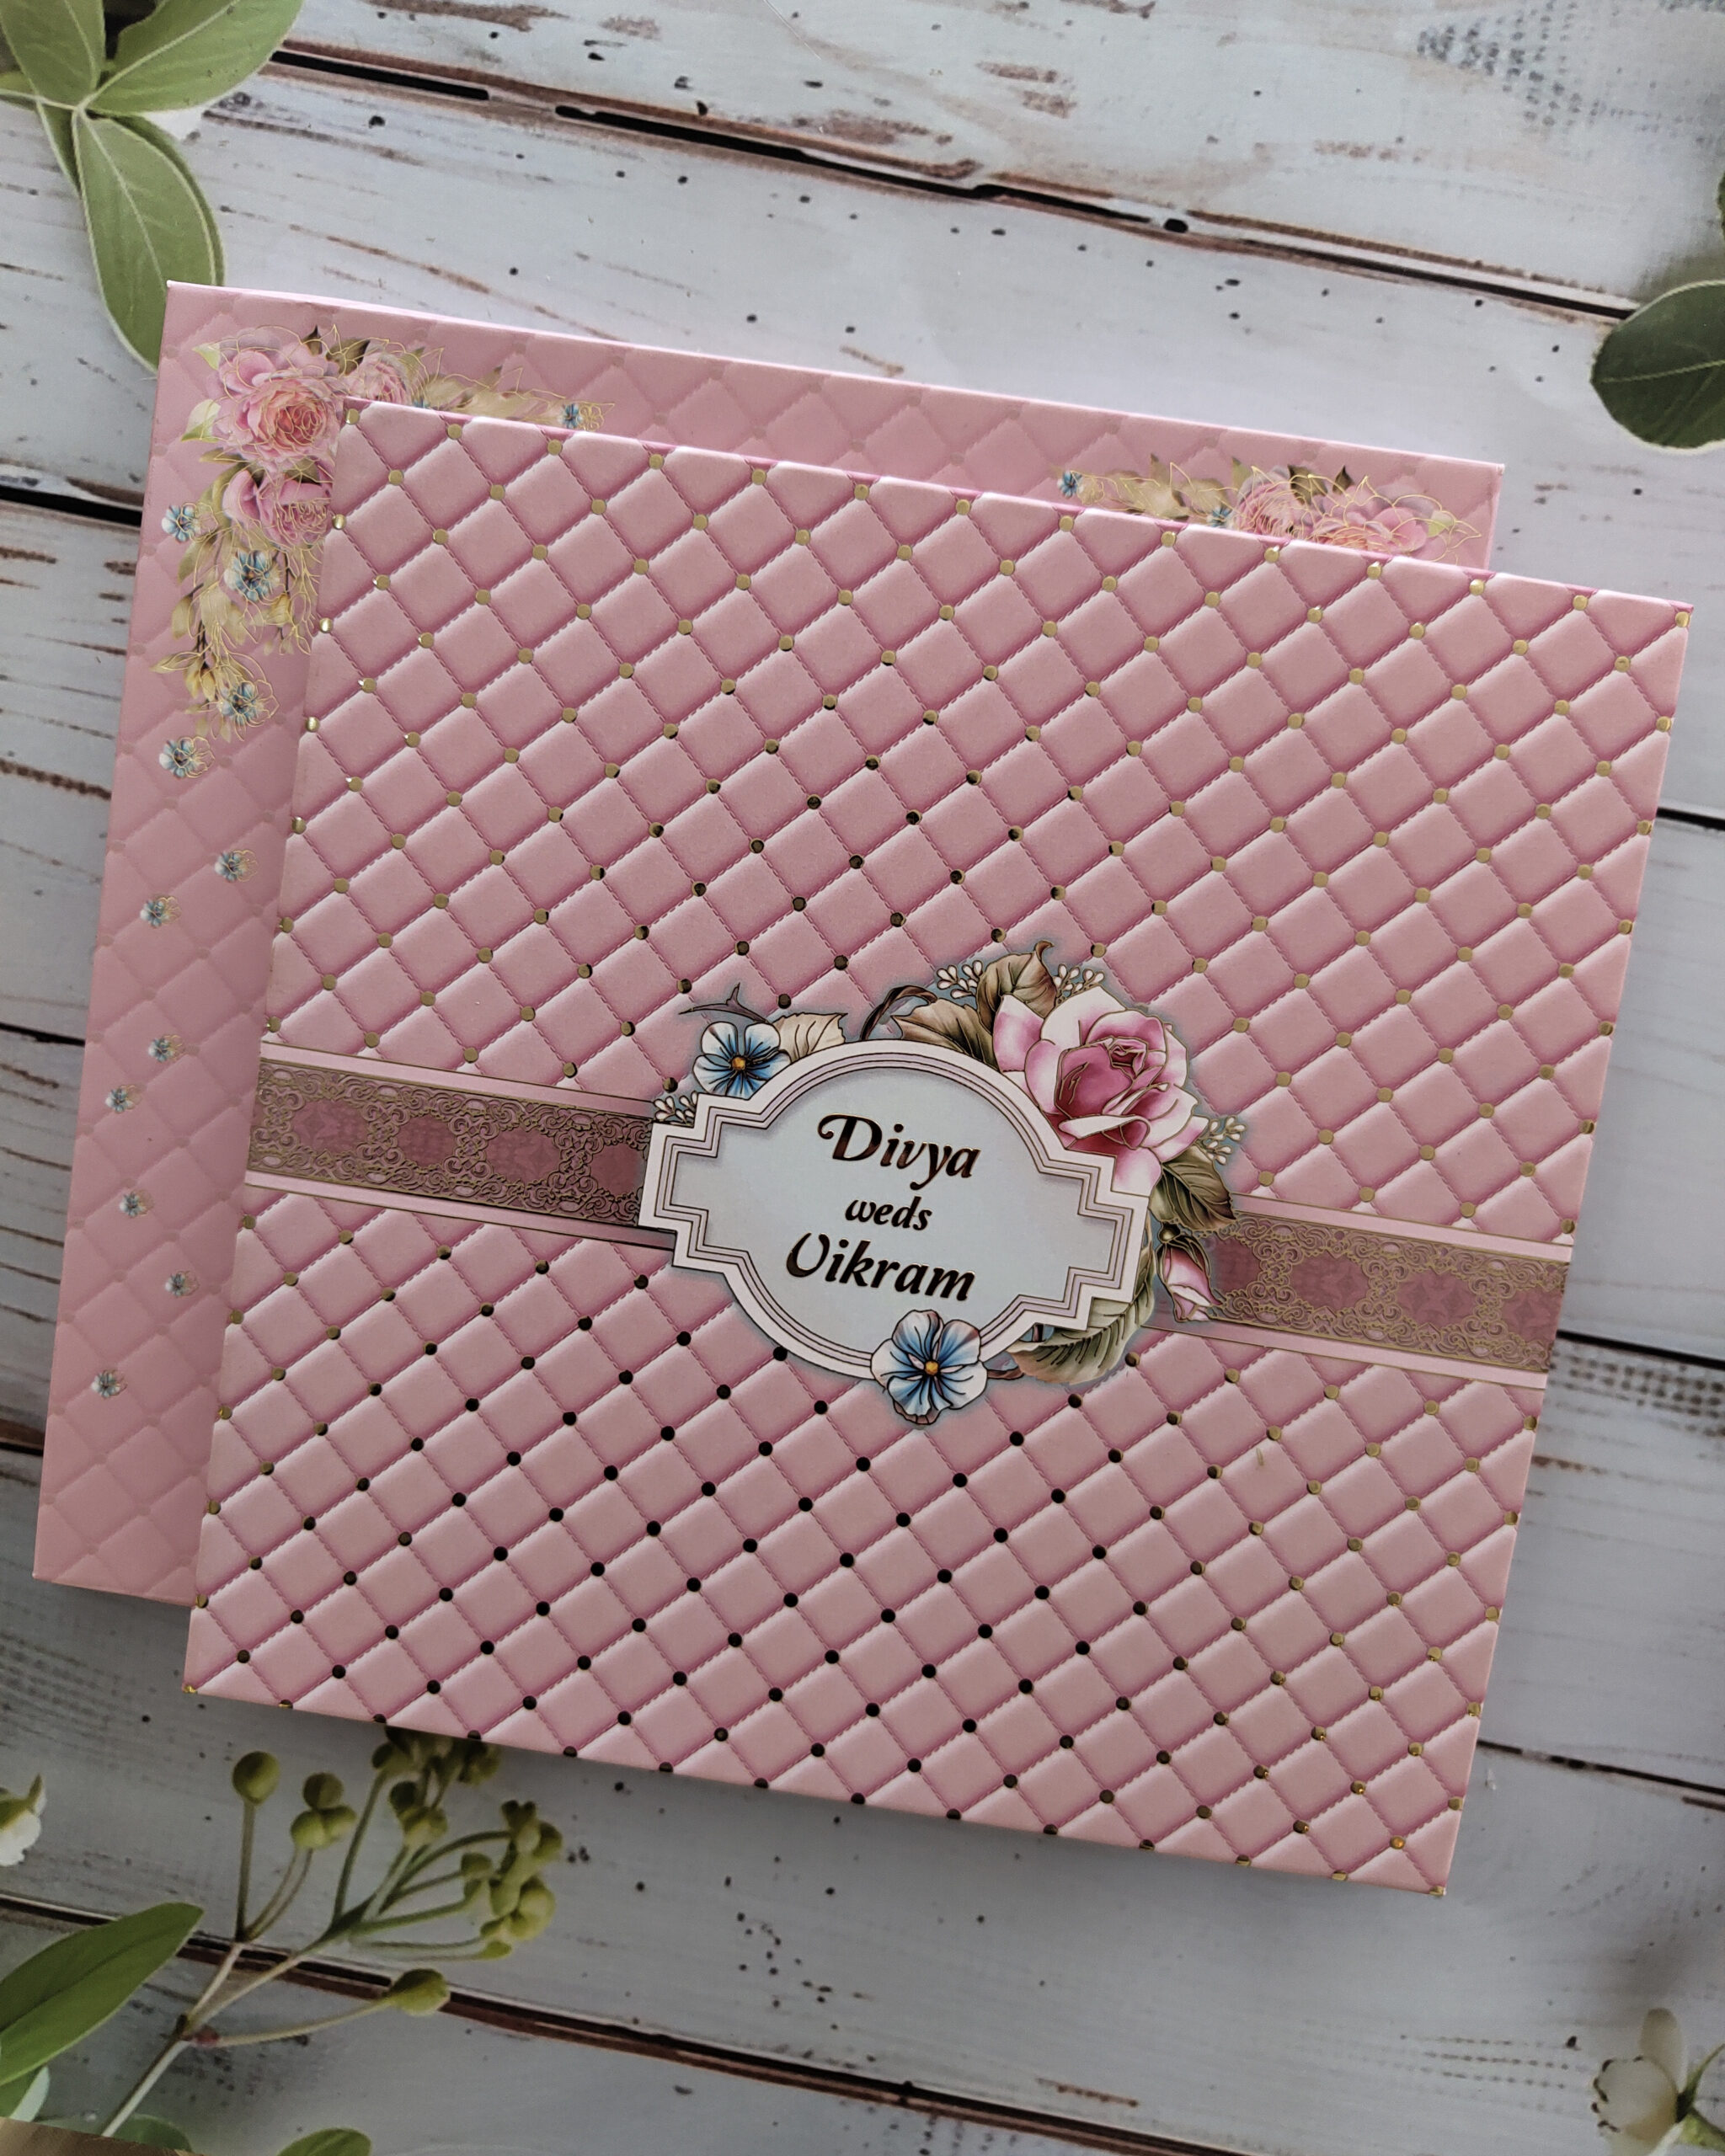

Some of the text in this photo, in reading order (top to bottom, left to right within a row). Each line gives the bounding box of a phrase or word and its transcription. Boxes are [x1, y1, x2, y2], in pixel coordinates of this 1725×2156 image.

[817, 1113, 981, 1191] Divya
[845, 1196, 932, 1231] weds
[786, 1232, 975, 1302] Vikram
